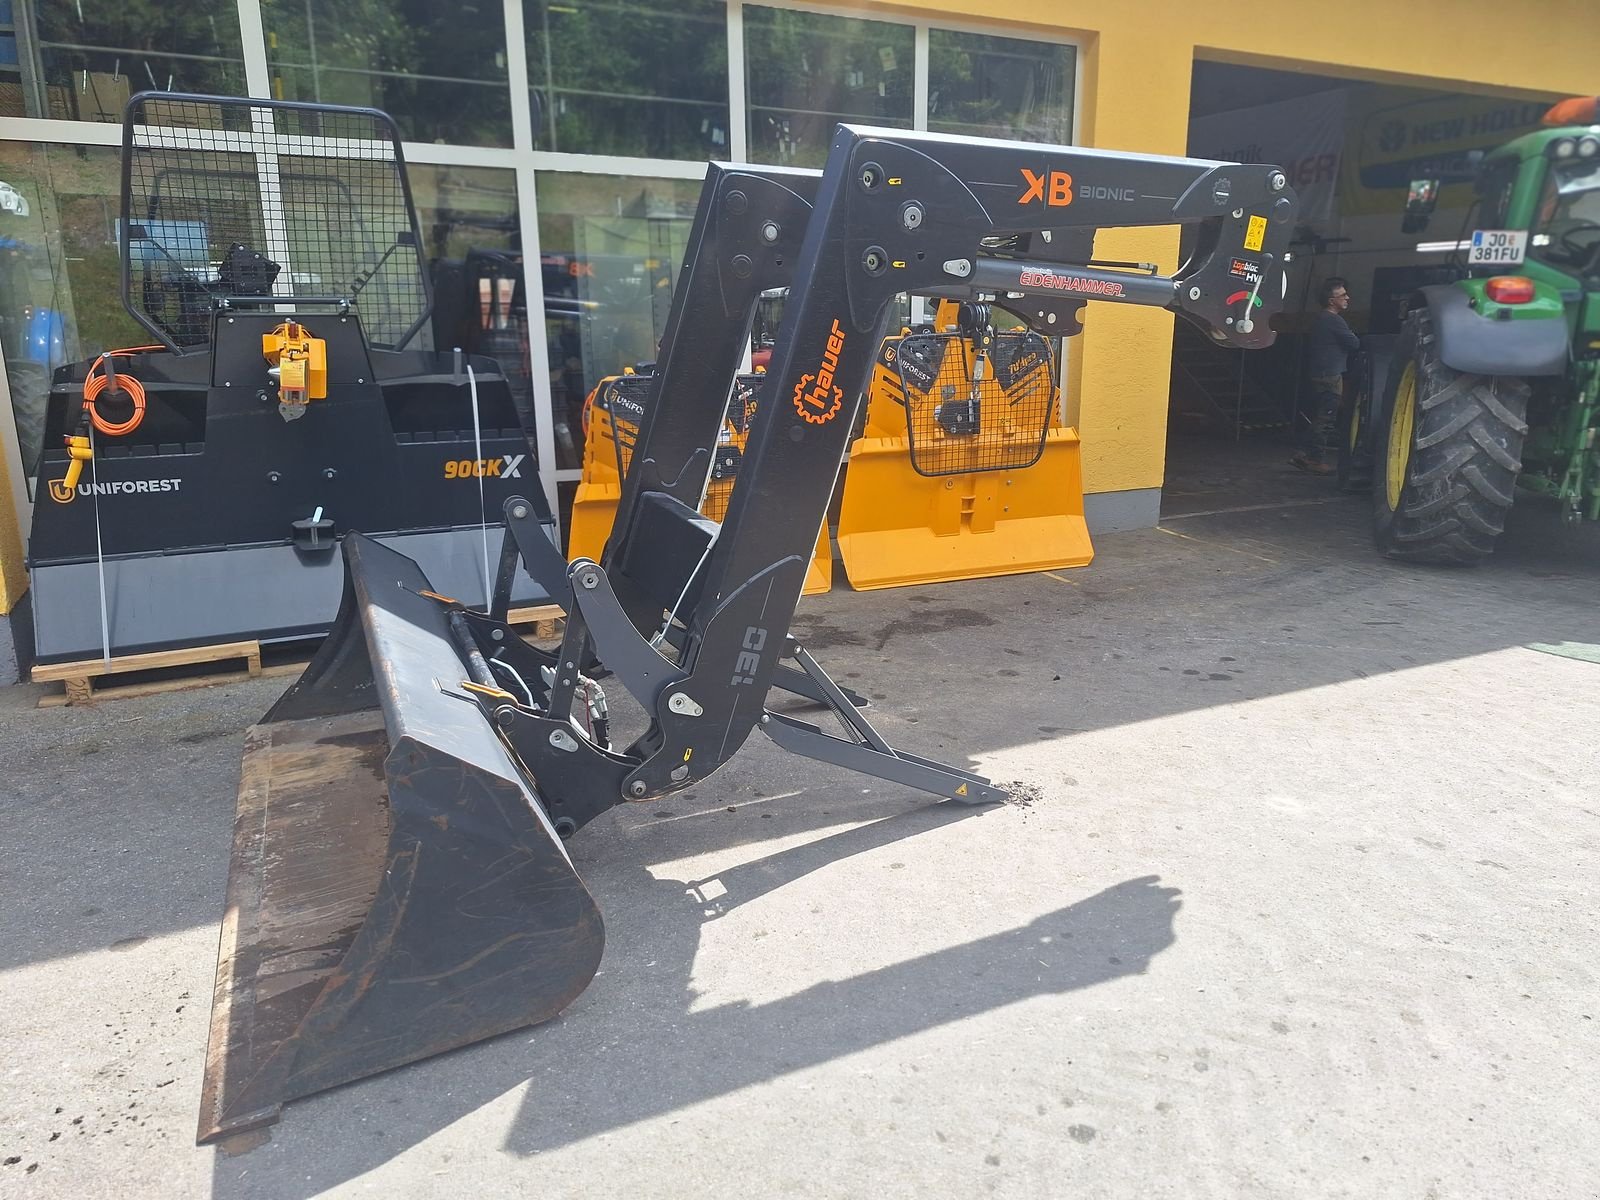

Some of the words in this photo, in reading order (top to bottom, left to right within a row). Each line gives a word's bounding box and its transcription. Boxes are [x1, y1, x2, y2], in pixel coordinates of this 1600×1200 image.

[1018, 168, 1074, 207] XB
[1079, 185, 1136, 202] BIONIC
[1489, 233, 1507, 247] JO
[1475, 247, 1520, 261] 381FU
[1019, 271, 1125, 298] EIDENHAMMER
[804, 318, 846, 410] hauer
[616, 394, 645, 416] UNIFO
[77, 478, 182, 497] UNIFOREST
